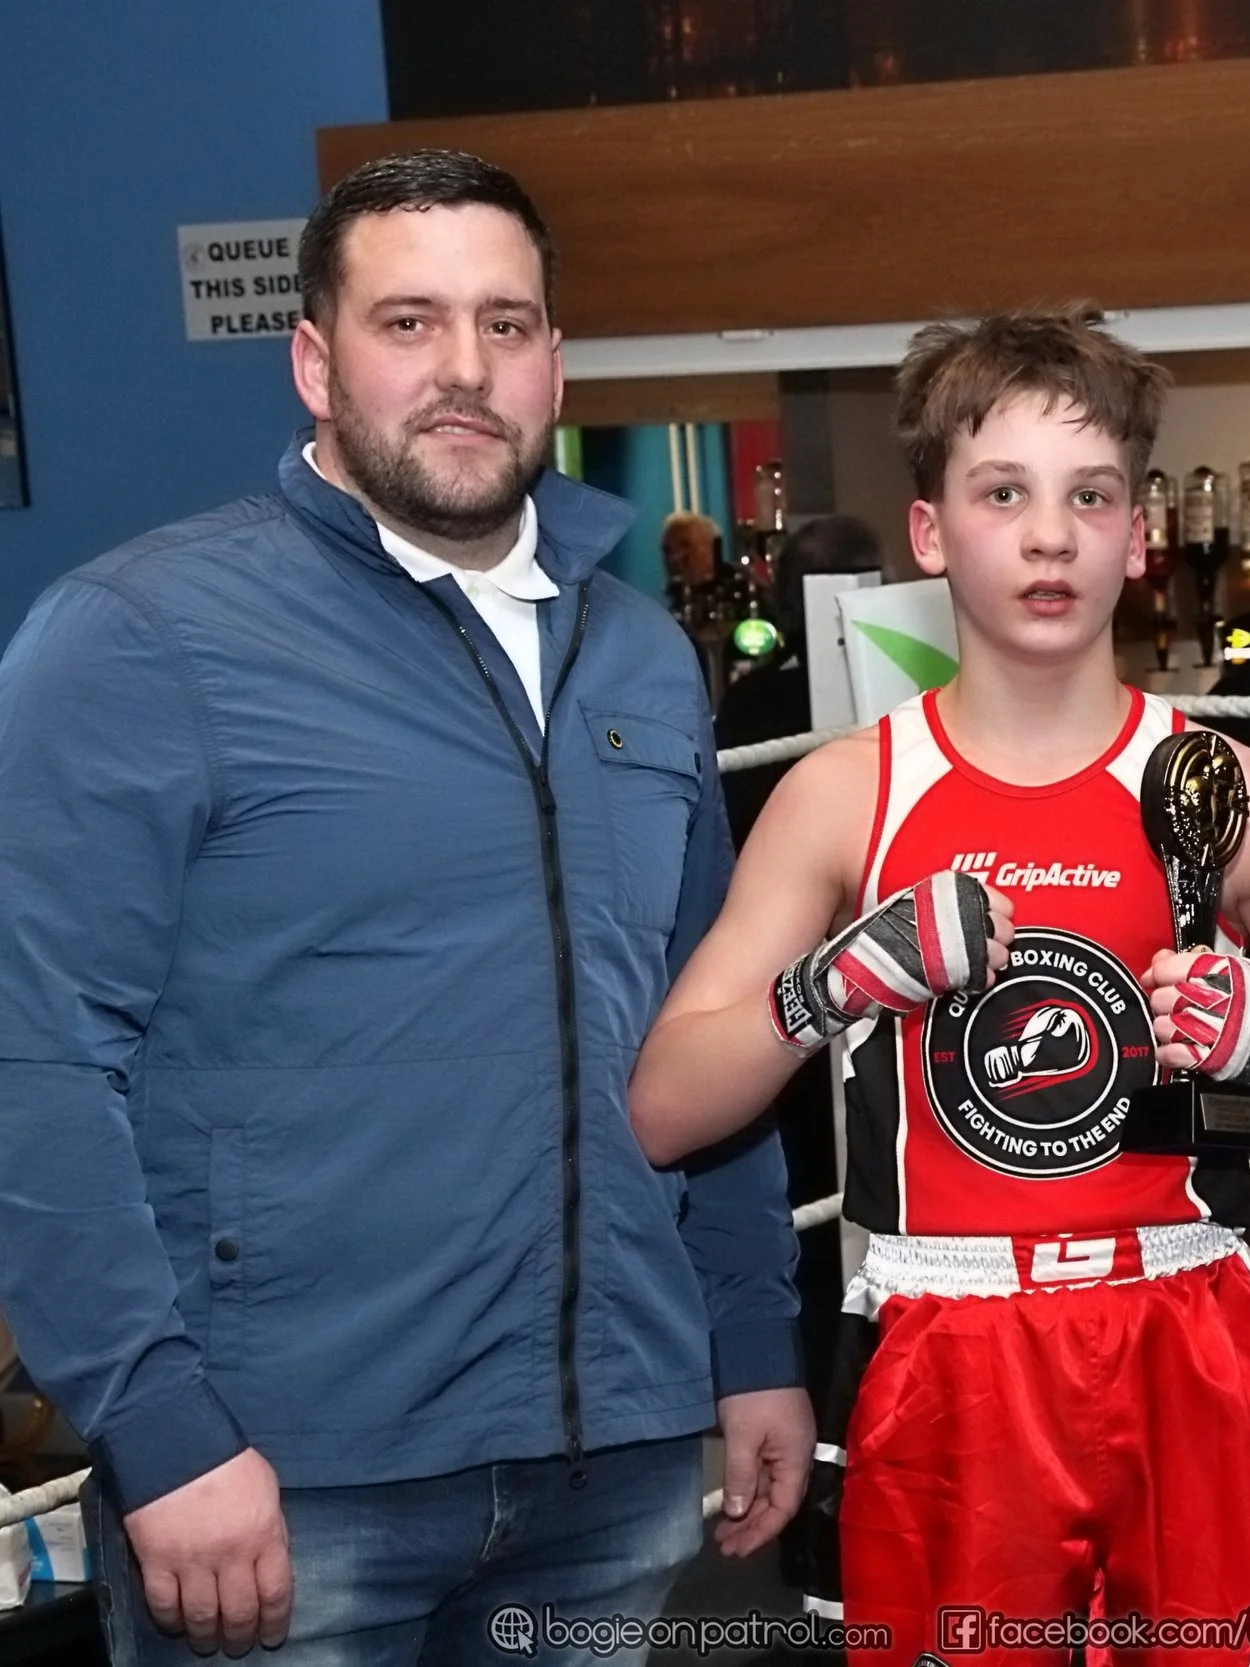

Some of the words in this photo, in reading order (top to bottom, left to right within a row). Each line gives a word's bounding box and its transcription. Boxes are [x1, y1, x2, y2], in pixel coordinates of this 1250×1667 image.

[207, 237, 290, 262] QUEUE
[190, 277, 246, 300] THIS
[210, 310, 301, 335] PLEASE
[994, 862, 1122, 893] GripActive
[1009, 948, 1089, 978] BOXING
[1072, 971, 1127, 1016] CLUB
[934, 1051, 956, 1064] EST
[1121, 1046, 1149, 1059] 2017
[957, 1099, 1038, 1158] FIGHTING
[1040, 1140, 1069, 1158] TO
[1068, 1125, 1107, 1152] THE
[1099, 1096, 1132, 1134] END
